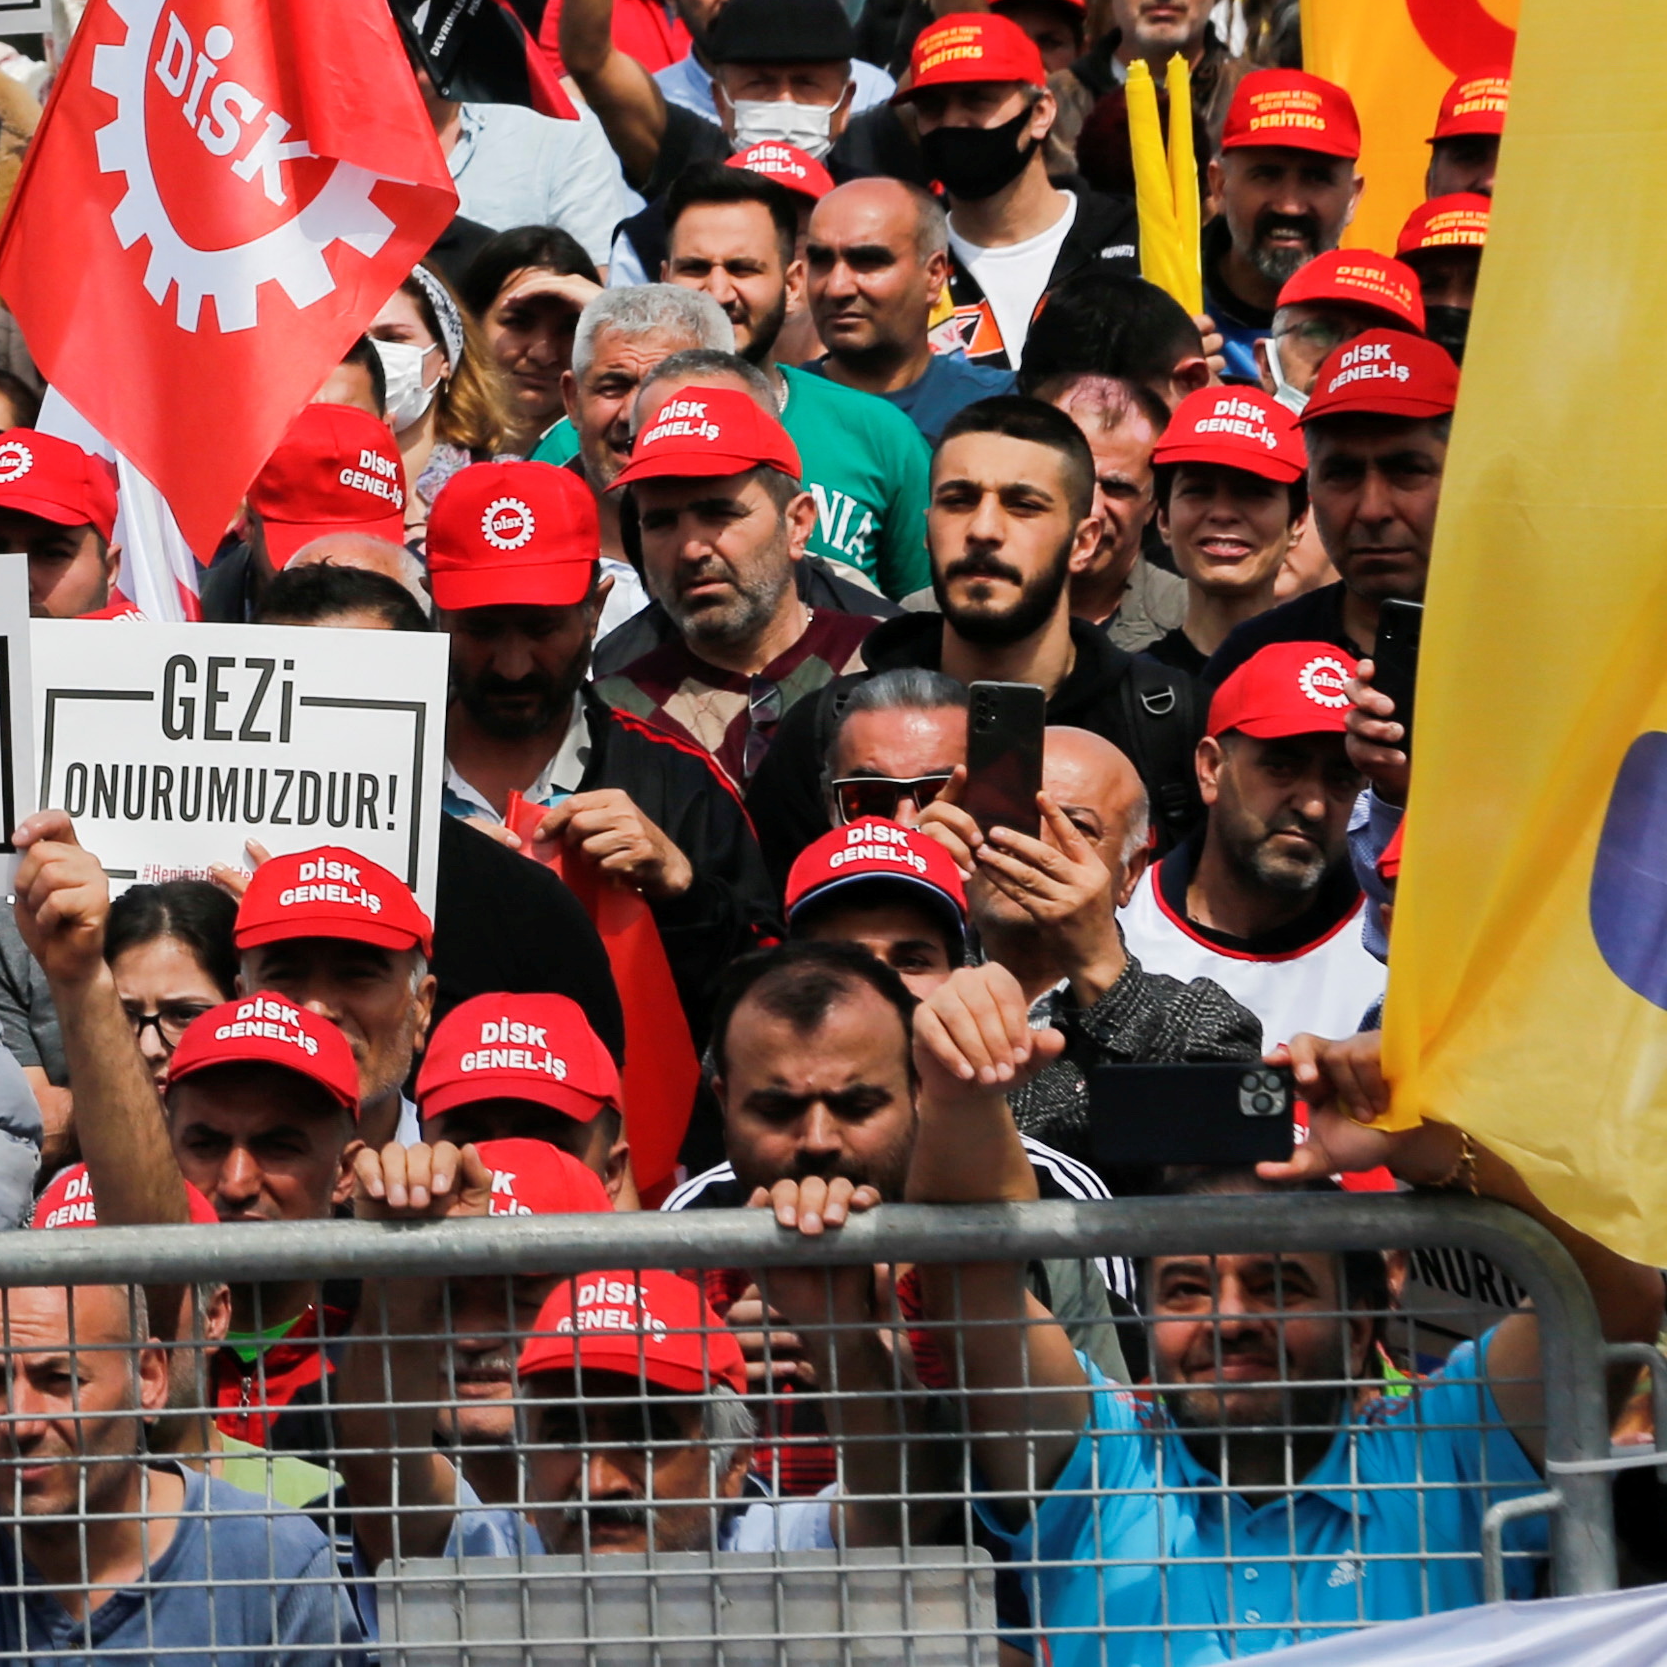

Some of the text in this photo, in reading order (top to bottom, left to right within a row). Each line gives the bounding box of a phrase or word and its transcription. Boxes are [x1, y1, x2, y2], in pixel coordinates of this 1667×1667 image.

[153, 8, 320, 208] DİSK
[1250, 109, 1326, 132] DERİTEKS
[747, 142, 793, 163] DİSK
[1341, 342, 1392, 369] DİSK
[1327, 361, 1410, 393] GENEL-İŞ
[658, 399, 708, 423] DİSK
[1212, 397, 1266, 423] DİSK
[642, 420, 721, 447] GENEL-İŞ
[1194, 417, 1278, 449] GENEL-İŞ
[358, 449, 398, 478] DİSK
[339, 467, 405, 509] GENEL-İŞ
[492, 513, 524, 531] DİSK
[1312, 674, 1344, 690] DİSK
[161, 654, 296, 745] GEZİ
[66, 762, 398, 832] ONURUMUZDUR!
[846, 821, 908, 847] DİSK
[298, 856, 360, 886] DİSK
[829, 845, 927, 875] GENEL-İŞ
[278, 884, 382, 914] GENEL-İŞ
[236, 997, 300, 1028] DİSK
[214, 1020, 319, 1055] GENEL-İŞ
[481, 1016, 547, 1048] DİSK
[459, 1047, 567, 1081] GENEL-İŞ
[578, 1276, 648, 1309] DİSK
